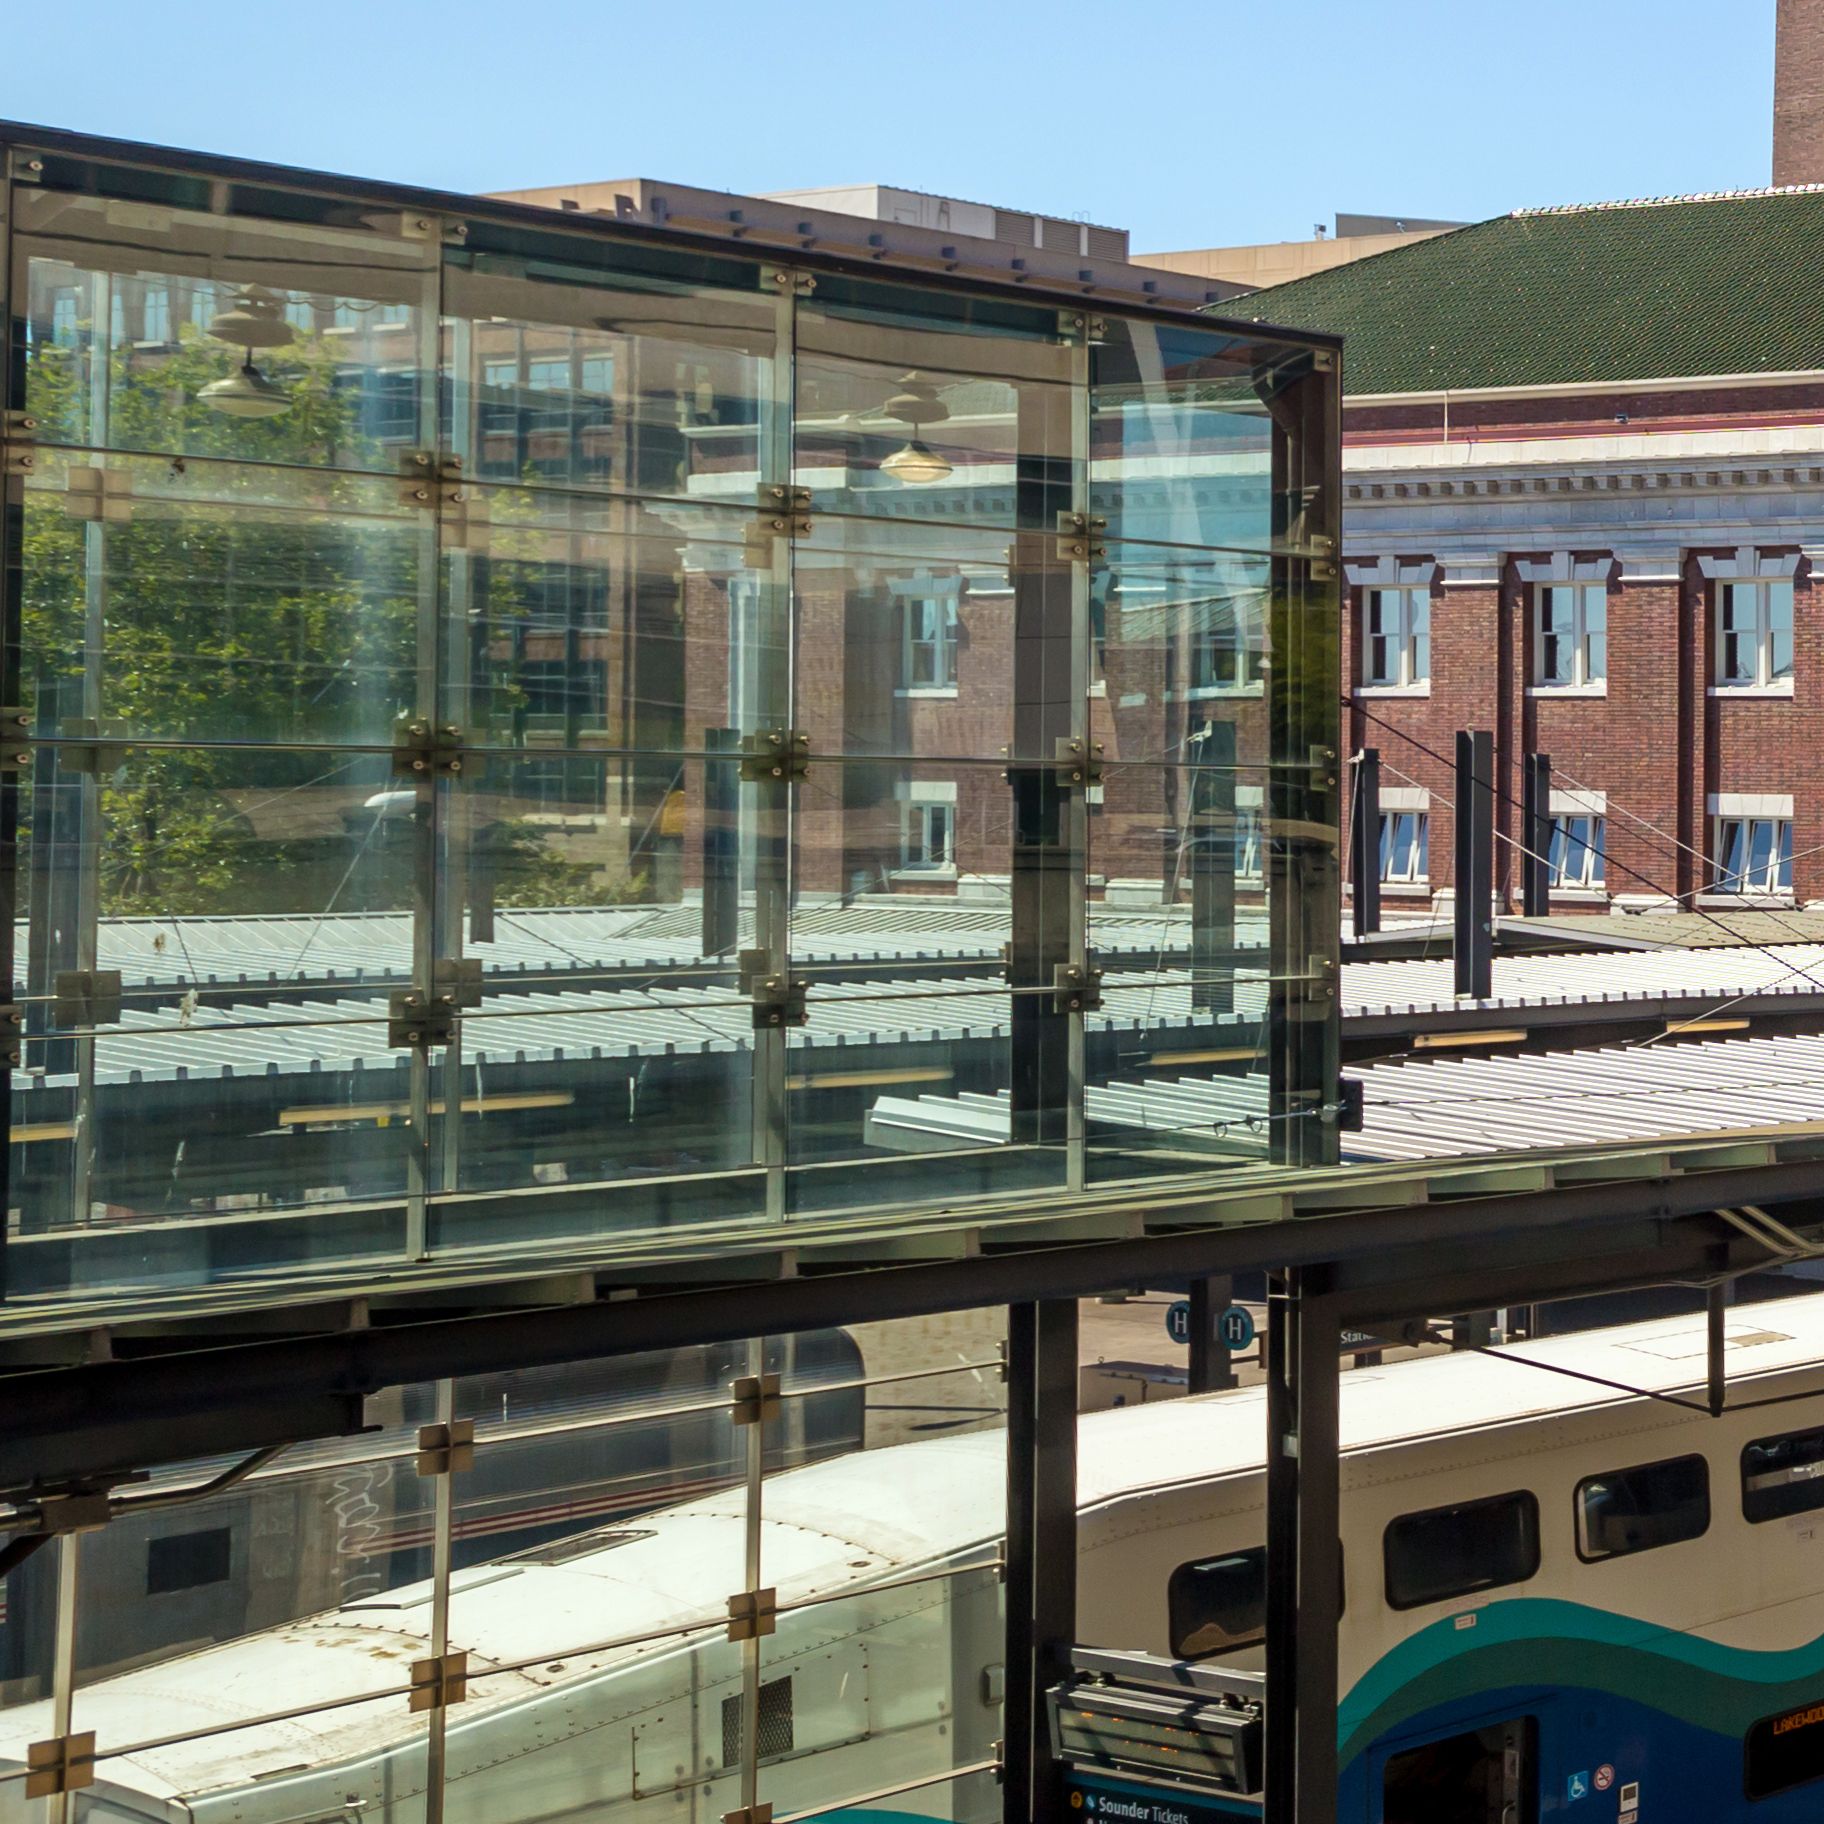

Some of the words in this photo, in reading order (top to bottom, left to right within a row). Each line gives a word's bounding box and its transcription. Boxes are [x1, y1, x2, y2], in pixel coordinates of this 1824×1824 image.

[1174, 1311, 1187, 1335] H
[1229, 1318, 1242, 1341] H
[1099, 1796, 1149, 1820] Sounder
[1152, 1805, 1188, 1824] Tickets
